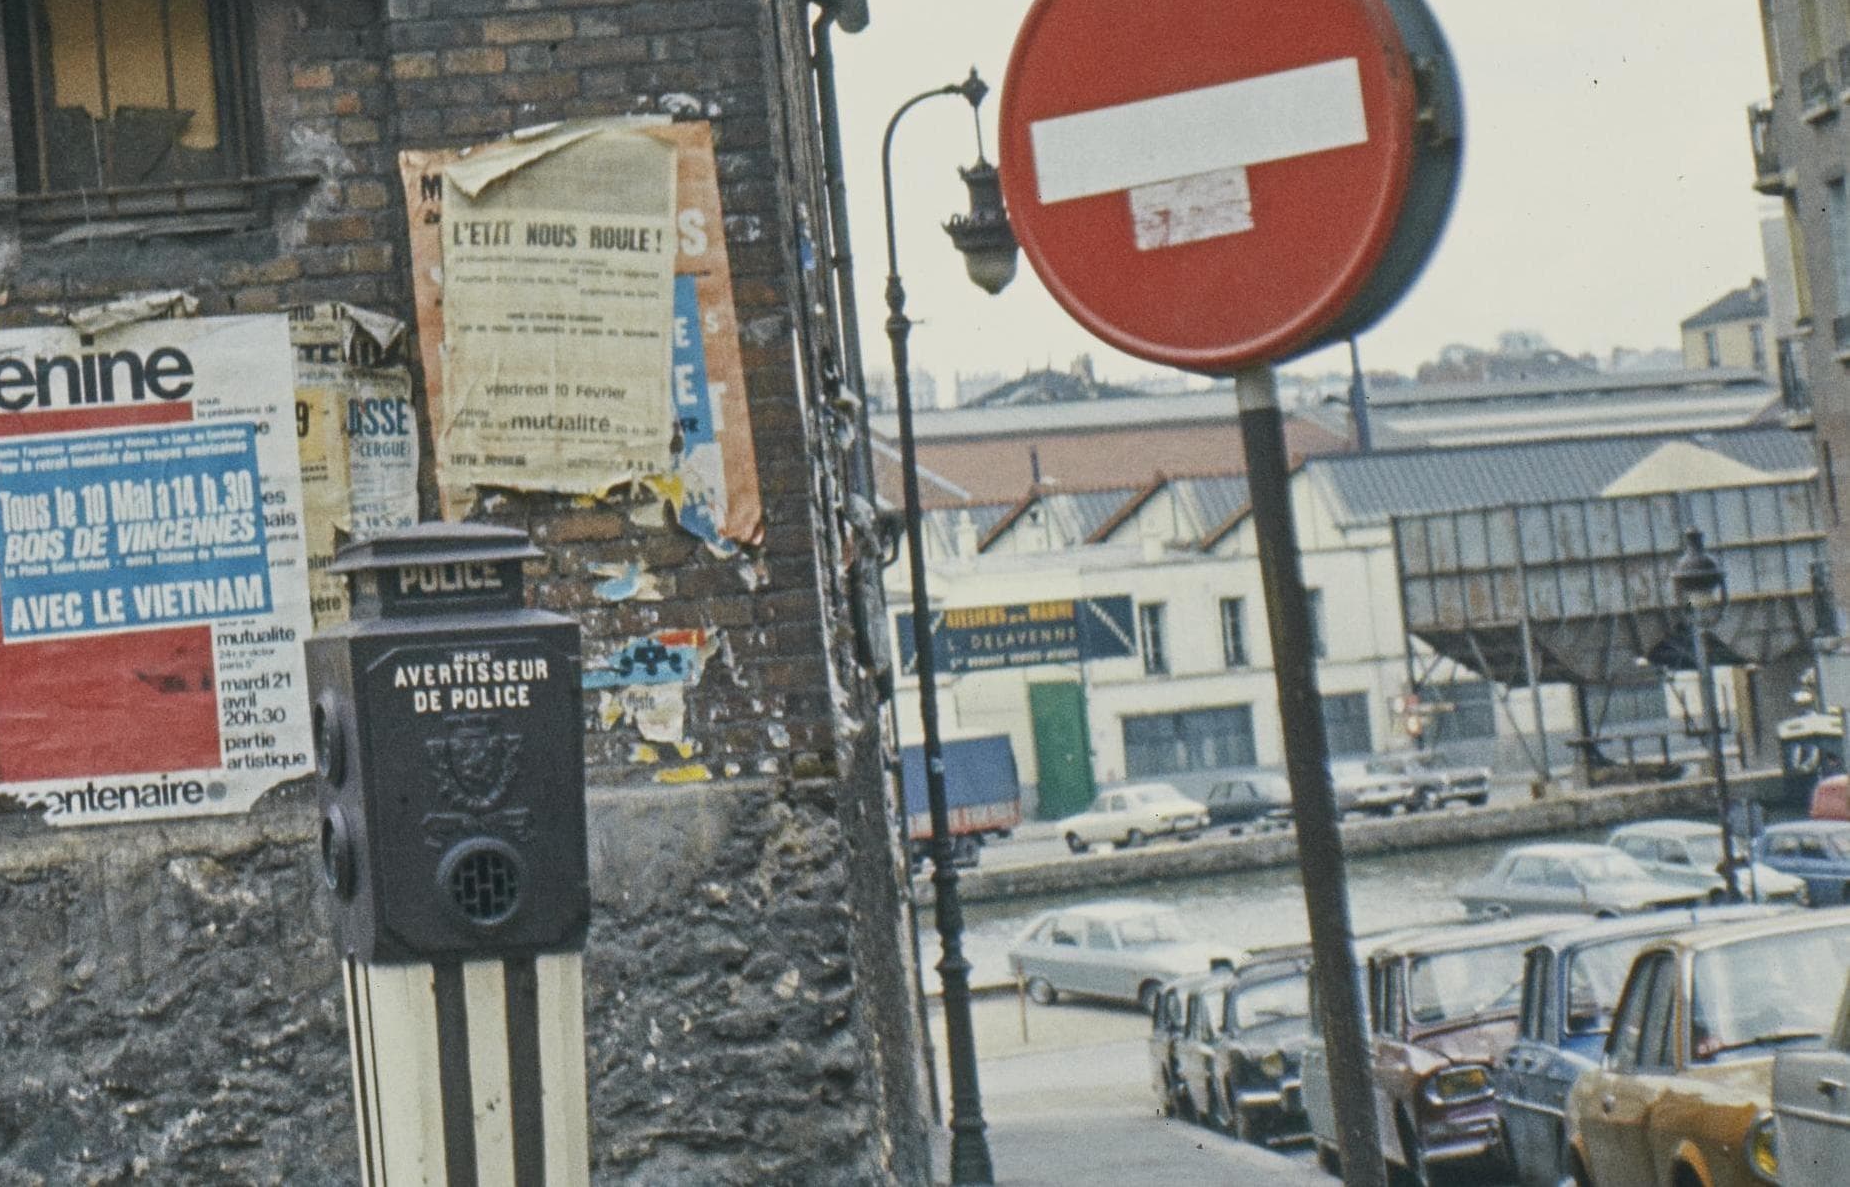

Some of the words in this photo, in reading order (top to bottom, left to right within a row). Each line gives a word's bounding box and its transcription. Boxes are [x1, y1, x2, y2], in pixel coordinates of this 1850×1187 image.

[525, 222, 578, 248] NOUS
[484, 382, 550, 399] vendredi
[574, 384, 628, 402] Février
[510, 410, 611, 433] mutualité
[0, 487, 51, 533] Tous
[54, 484, 77, 528] le
[80, 483, 108, 526] 10
[110, 478, 154, 522] Mai
[171, 475, 198, 517] 14
[5, 529, 67, 564] BOIS
[72, 524, 108, 559] DE
[117, 513, 257, 556] VINCENNES
[399, 561, 503, 594] POLICE
[10, 591, 85, 632] AVEC
[92, 586, 127, 624] LE
[132, 573, 265, 618] VIETNAM
[221, 674, 271, 693] mardi
[272, 673, 291, 689] 21
[394, 658, 550, 689] AVERTISSEUR
[222, 692, 257, 710] avril
[414, 690, 442, 713] DE
[450, 684, 531, 711] POLICE
[224, 732, 277, 753] partie
[226, 753, 308, 771] artistique
[47, 775, 205, 815] entenaire
